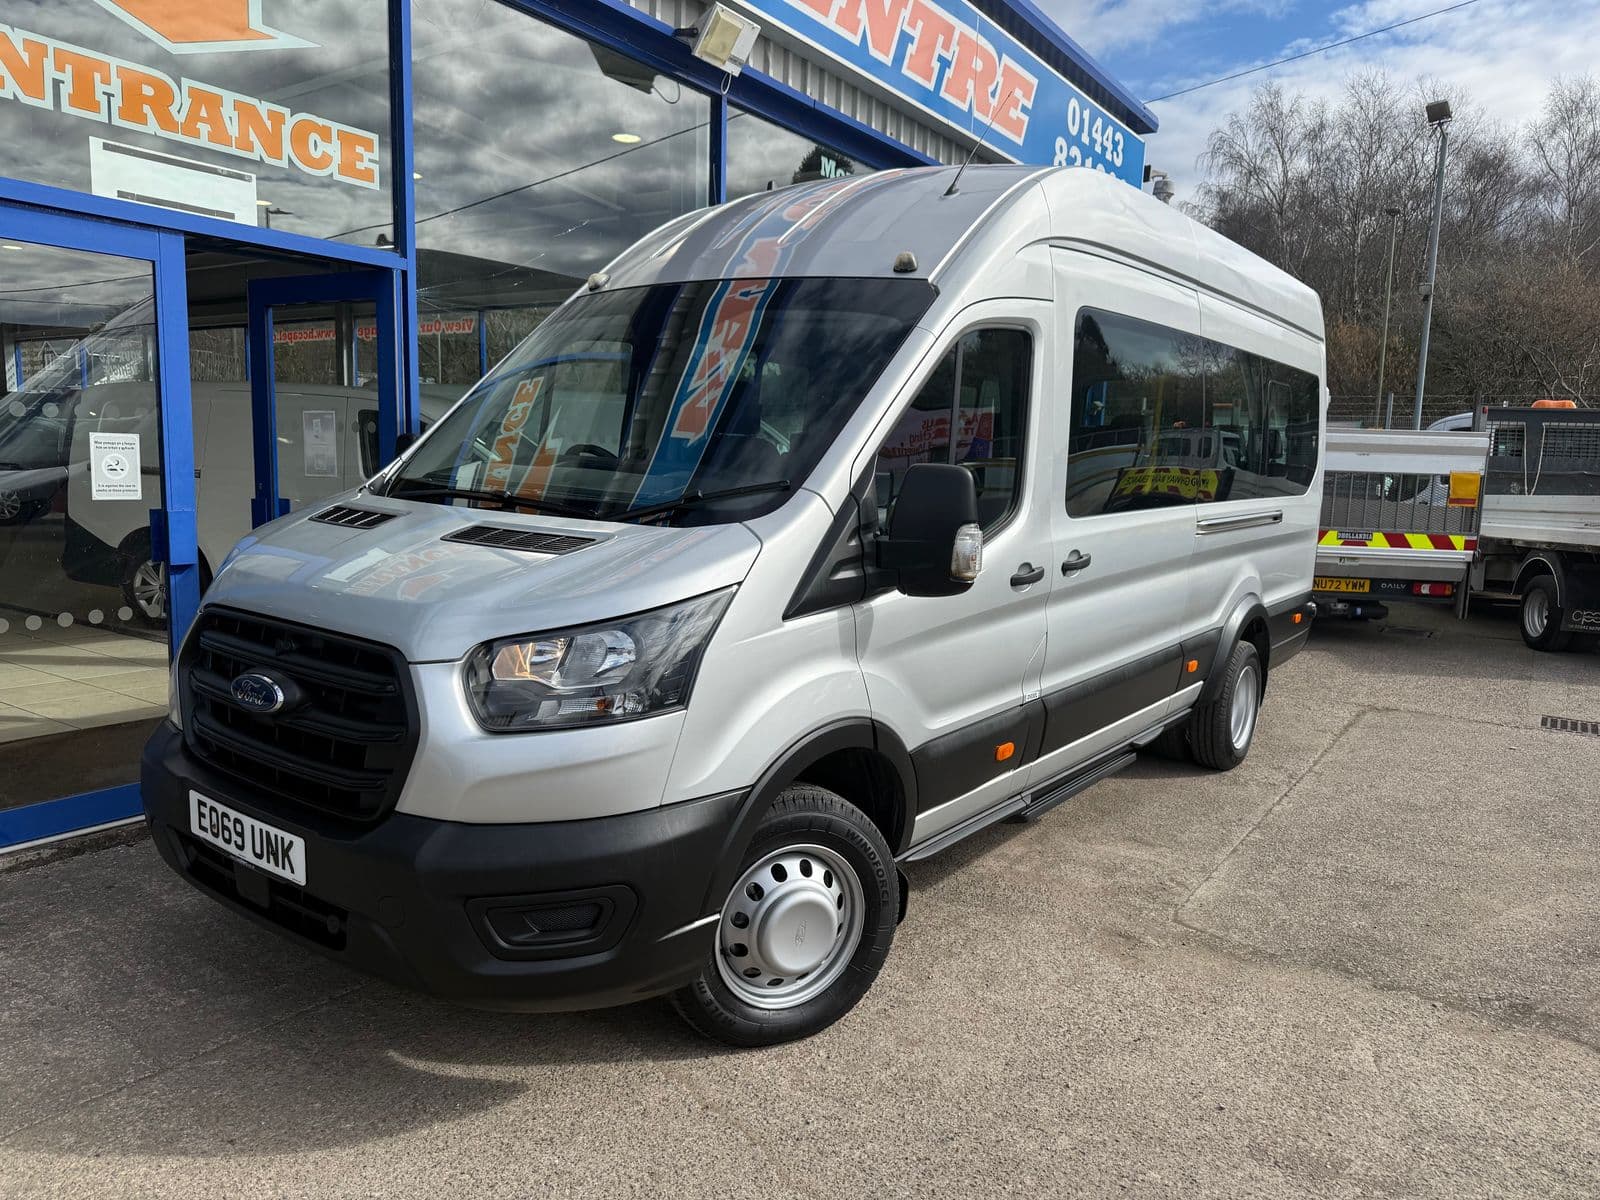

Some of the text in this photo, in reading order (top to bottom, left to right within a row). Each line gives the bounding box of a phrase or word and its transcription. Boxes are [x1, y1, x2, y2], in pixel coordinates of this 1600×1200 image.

[793, 0, 1037, 144] NTRE
[1067, 97, 1124, 167] 01443
[1313, 578, 1366, 591] NU72 YWM
[236, 679, 266, 706] Ford
[251, 824, 295, 875] UNK
[845, 828, 890, 908] WINDFORCE
